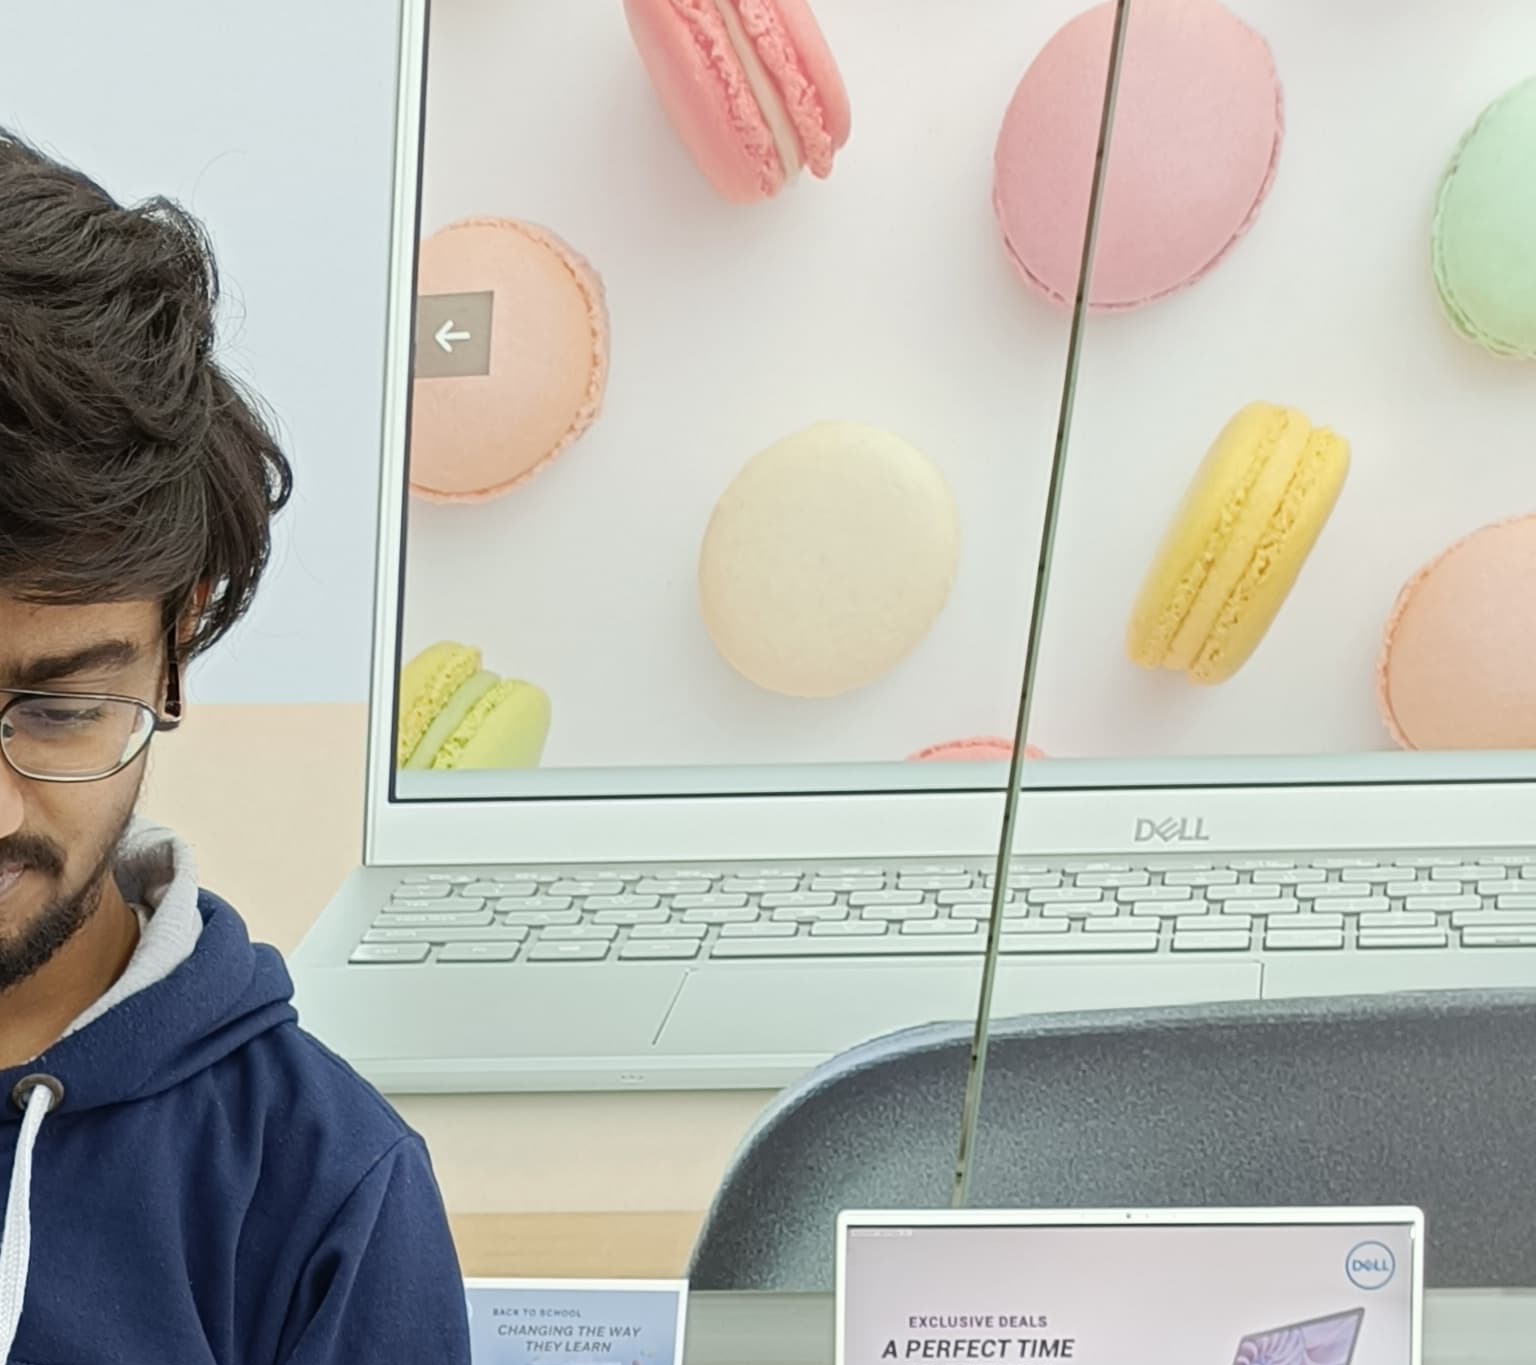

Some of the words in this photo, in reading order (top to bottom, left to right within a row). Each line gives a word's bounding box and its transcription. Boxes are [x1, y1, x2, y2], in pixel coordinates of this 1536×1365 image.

[1134, 817, 1210, 842] DELL
[493, 1308, 519, 1317] BACK
[523, 1309, 536, 1317] TO
[540, 1309, 582, 1318] SCHOOL
[909, 1316, 994, 1328] EXCLUSIVE
[999, 1316, 1048, 1328] DEALS
[497, 1324, 573, 1337] CHANGING
[578, 1325, 606, 1337] THE
[609, 1326, 642, 1338] WAY
[526, 1341, 563, 1352] THEY
[565, 1341, 612, 1353] LEARN
[881, 1339, 898, 1359] A
[905, 1339, 1012, 1358] PERFECT
[1017, 1339, 1075, 1358] TIME
